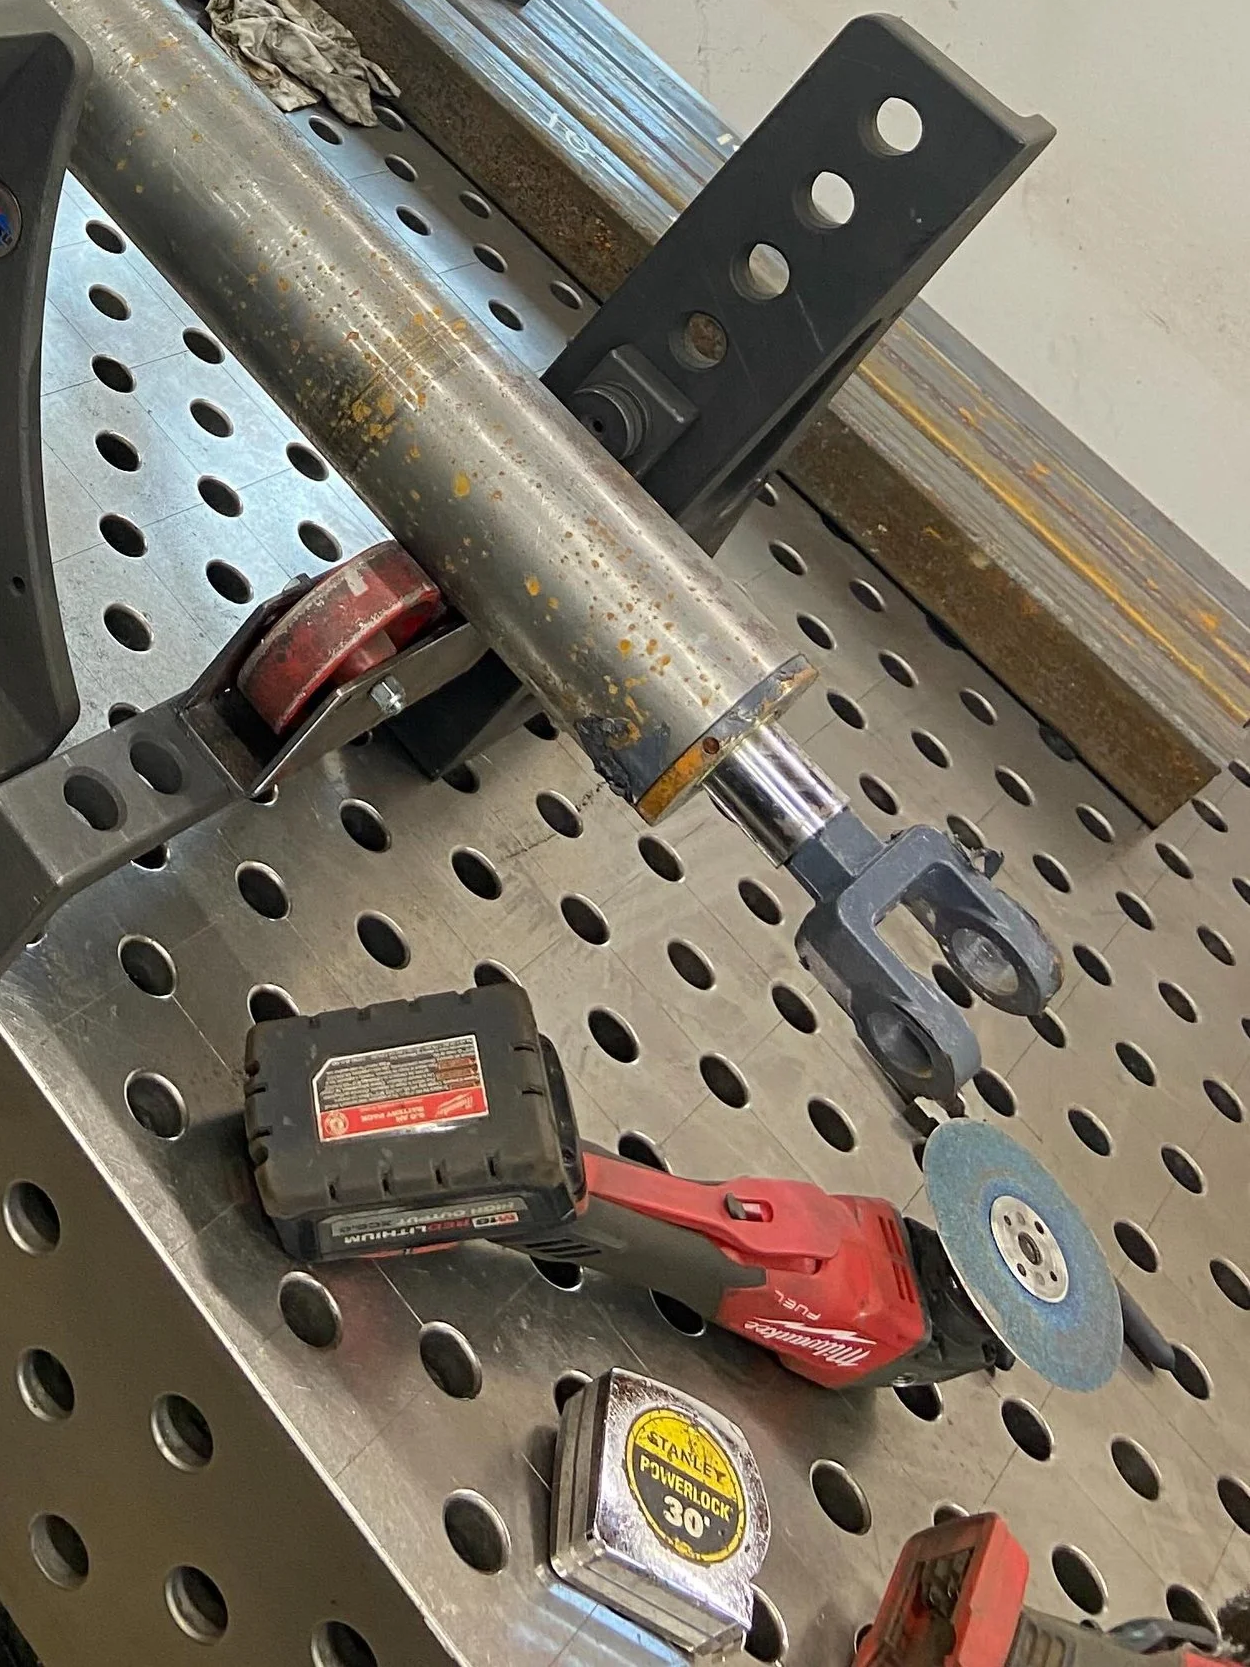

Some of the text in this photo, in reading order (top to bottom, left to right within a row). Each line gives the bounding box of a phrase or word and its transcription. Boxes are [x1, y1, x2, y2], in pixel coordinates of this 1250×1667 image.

[384, 1104, 425, 1118] BATTERY
[395, 1207, 466, 1226] OUTPUT
[469, 1200, 514, 1216] HIGH
[773, 1289, 821, 1320] FUEL
[743, 1317, 871, 1369] Milwaukee
[646, 1430, 727, 1483] STANLEY
[640, 1456, 732, 1521] POWERLOCK
[663, 1493, 711, 1538] 30'
